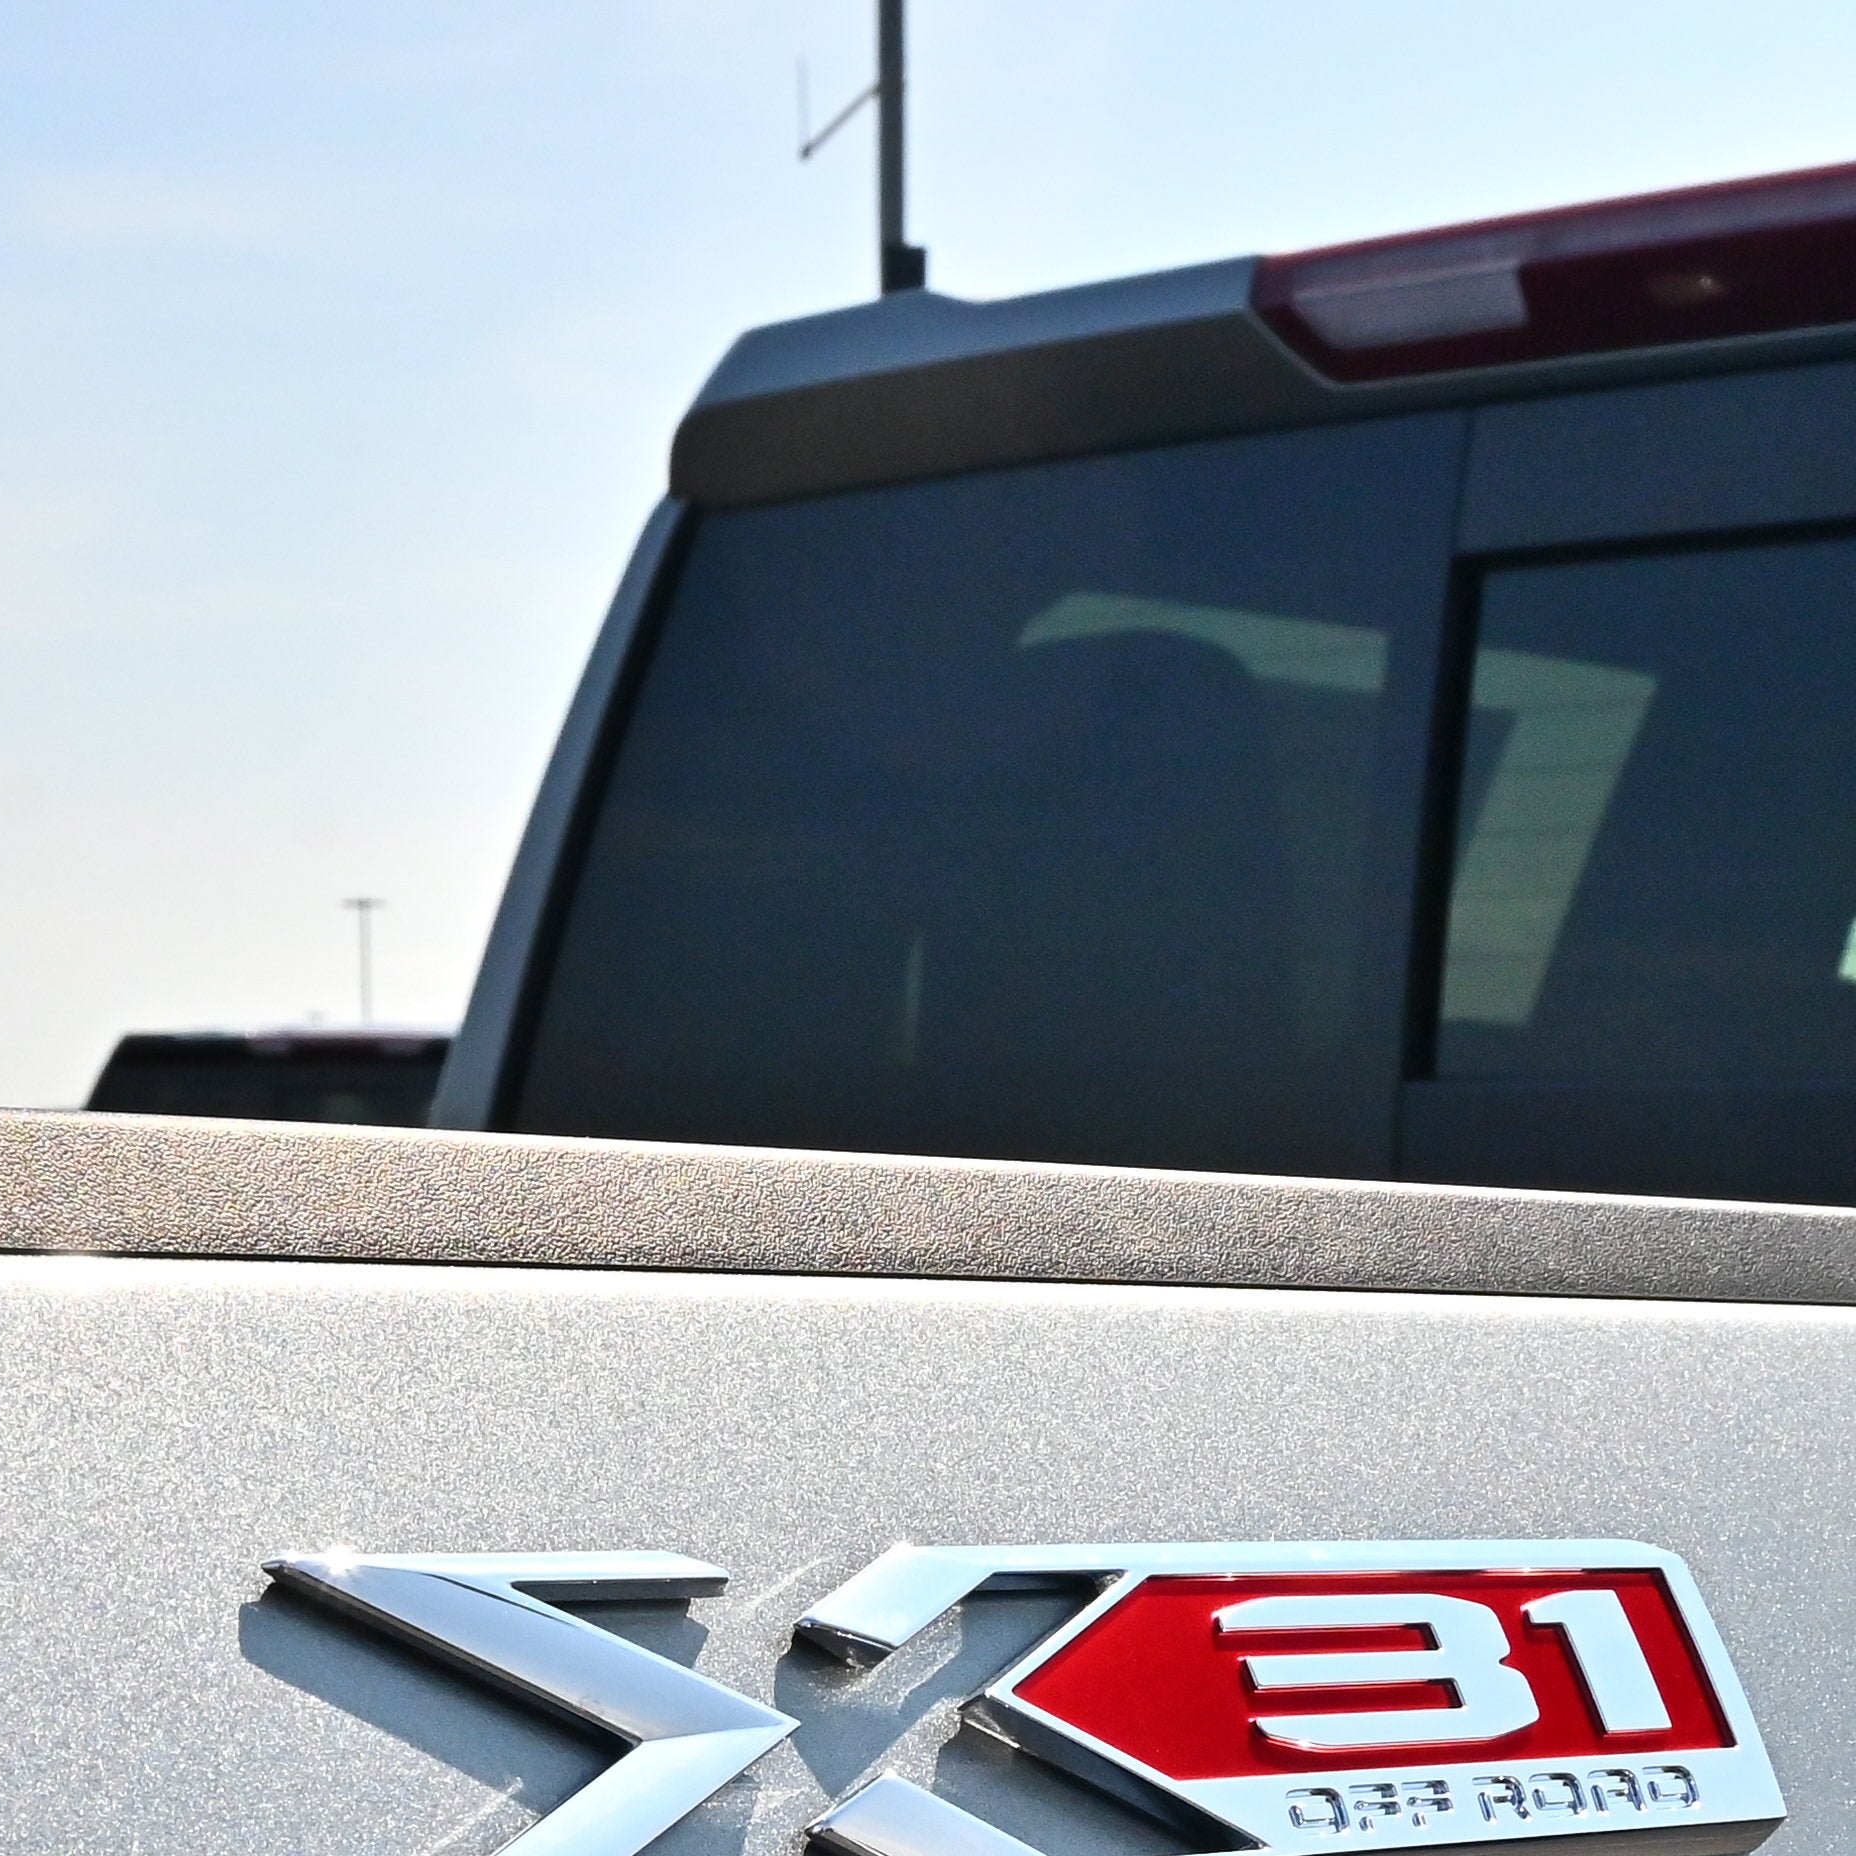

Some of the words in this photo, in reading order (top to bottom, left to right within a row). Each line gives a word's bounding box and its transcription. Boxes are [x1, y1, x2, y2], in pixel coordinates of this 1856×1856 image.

[1212, 1588, 1672, 1750] 31
[1284, 1779, 1453, 1834] OFF
[1472, 1764, 1701, 1823] ROAD
